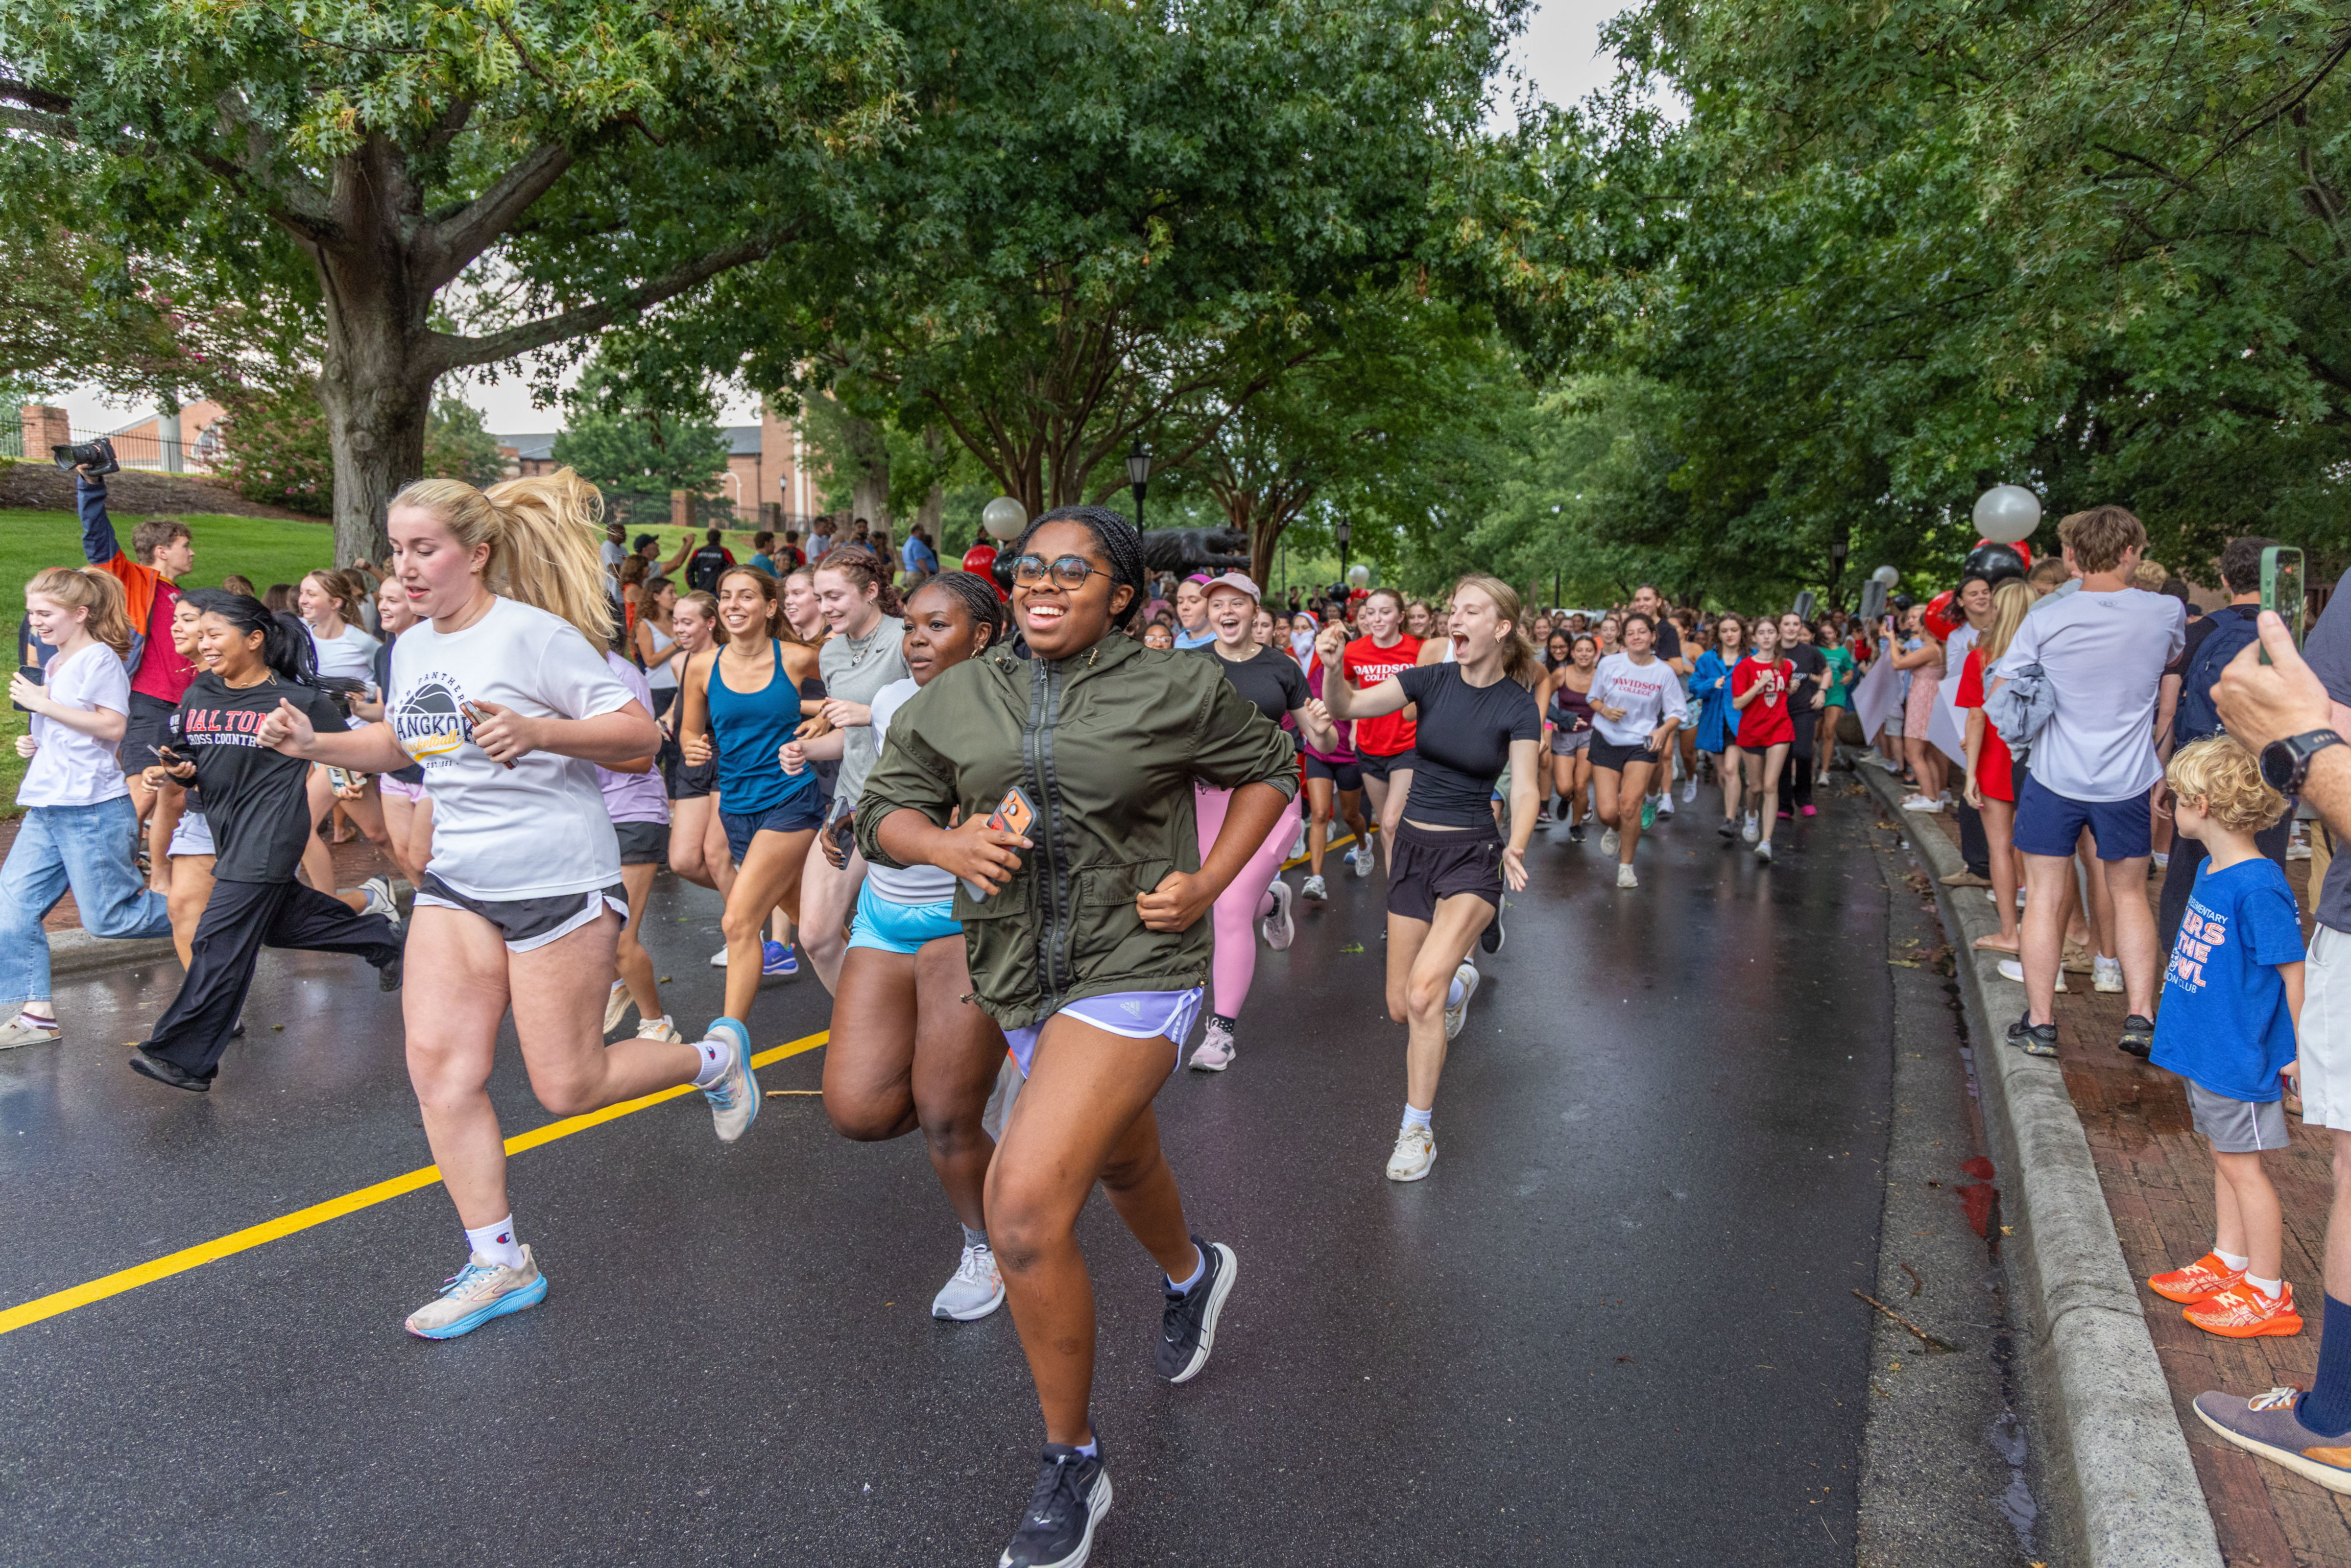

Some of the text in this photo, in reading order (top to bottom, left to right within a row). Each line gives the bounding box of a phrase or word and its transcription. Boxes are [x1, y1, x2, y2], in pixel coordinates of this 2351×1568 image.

[1613, 678, 1662, 692] DAVIDSON
[1619, 686, 1652, 696] COLLEGE
[393, 714, 477, 744] ANGKOK
[215, 733, 264, 748] COUNTR
[2182, 907, 2226, 946] ERS
[2178, 930, 2211, 964] THE
[2179, 978, 2197, 994] CLUB
